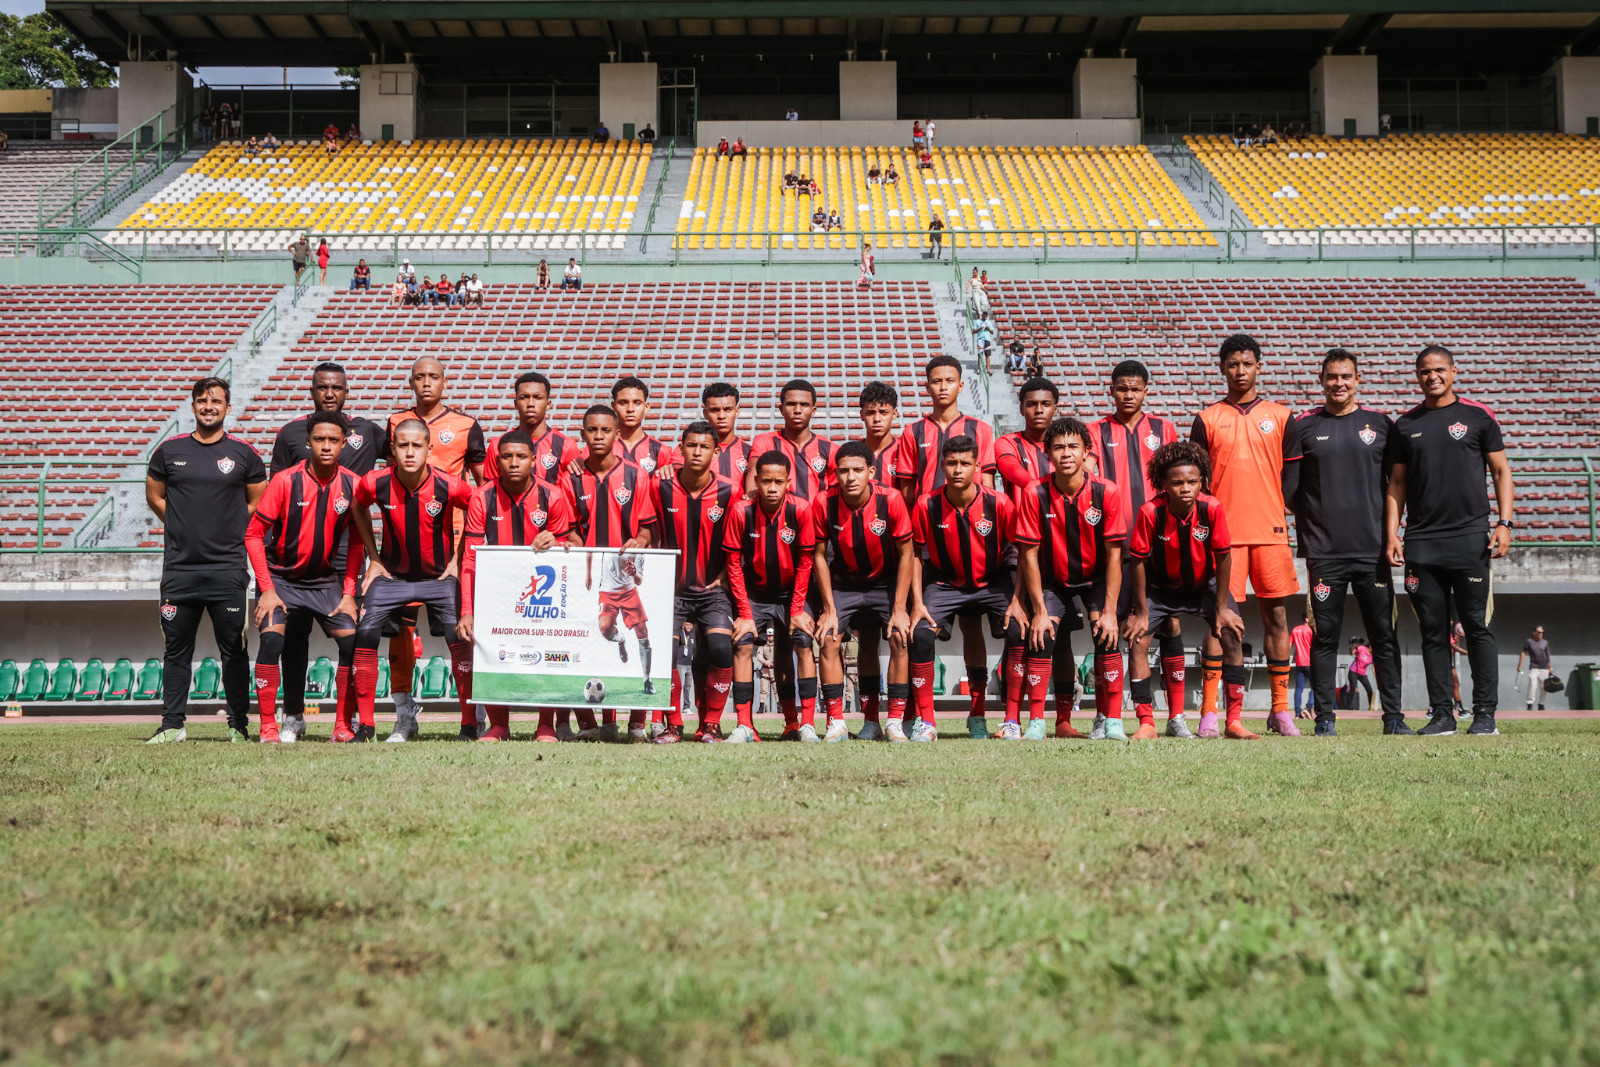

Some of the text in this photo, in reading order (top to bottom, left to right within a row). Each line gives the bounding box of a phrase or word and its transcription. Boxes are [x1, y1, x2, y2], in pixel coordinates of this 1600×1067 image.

[529, 565, 556, 605] 2
[514, 605, 559, 619] DE JULHO
[491, 627, 589, 637] MAIOR COPA SUB-15 DO BRASIL!
